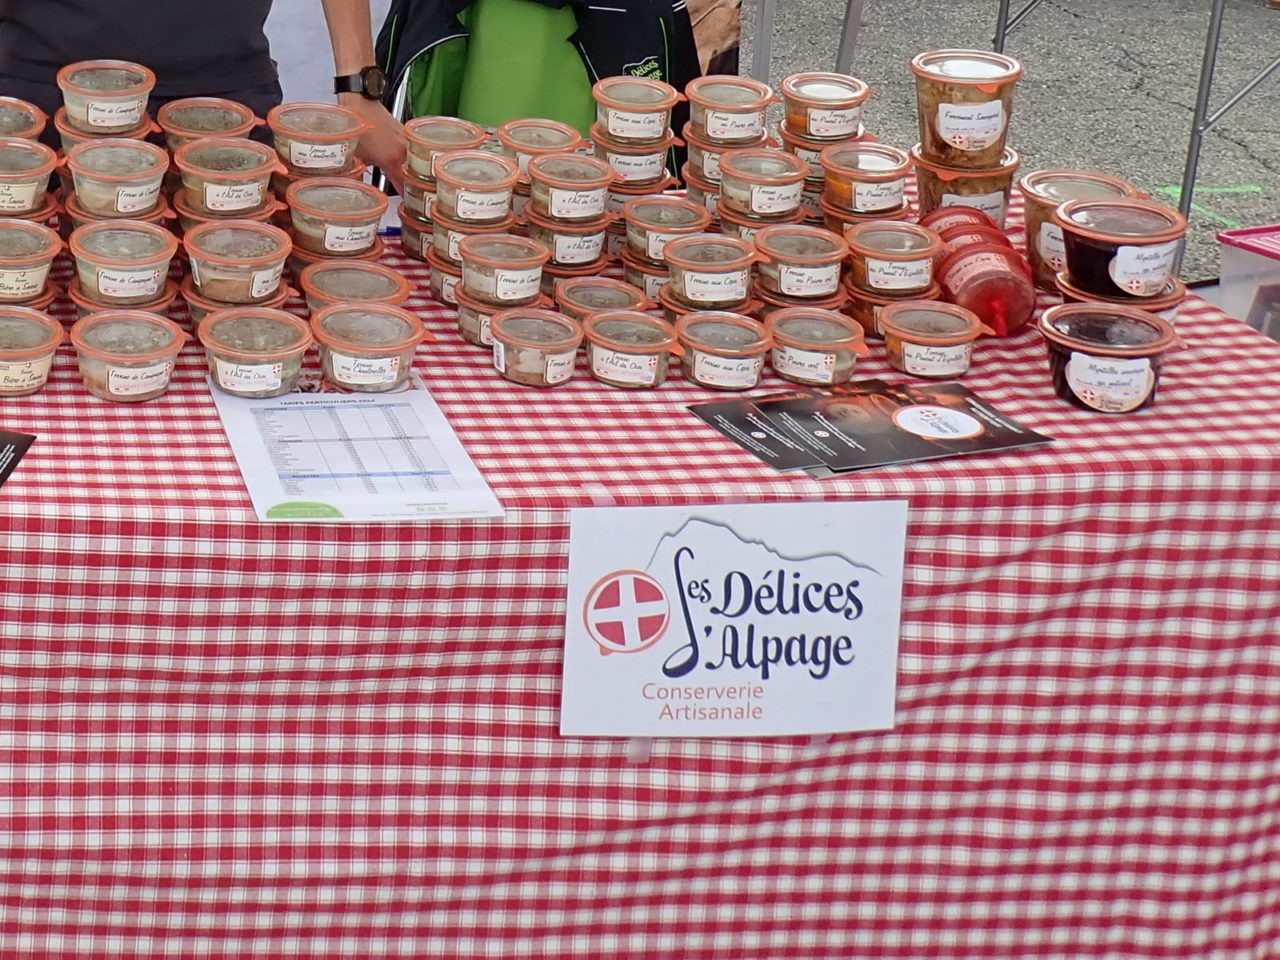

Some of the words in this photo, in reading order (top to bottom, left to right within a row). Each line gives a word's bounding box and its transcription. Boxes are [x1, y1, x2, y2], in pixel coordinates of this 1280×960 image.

[710, 568, 864, 621] Délices
[642, 682, 764, 700] Conserverie
[658, 701, 763, 721] Artisanale
